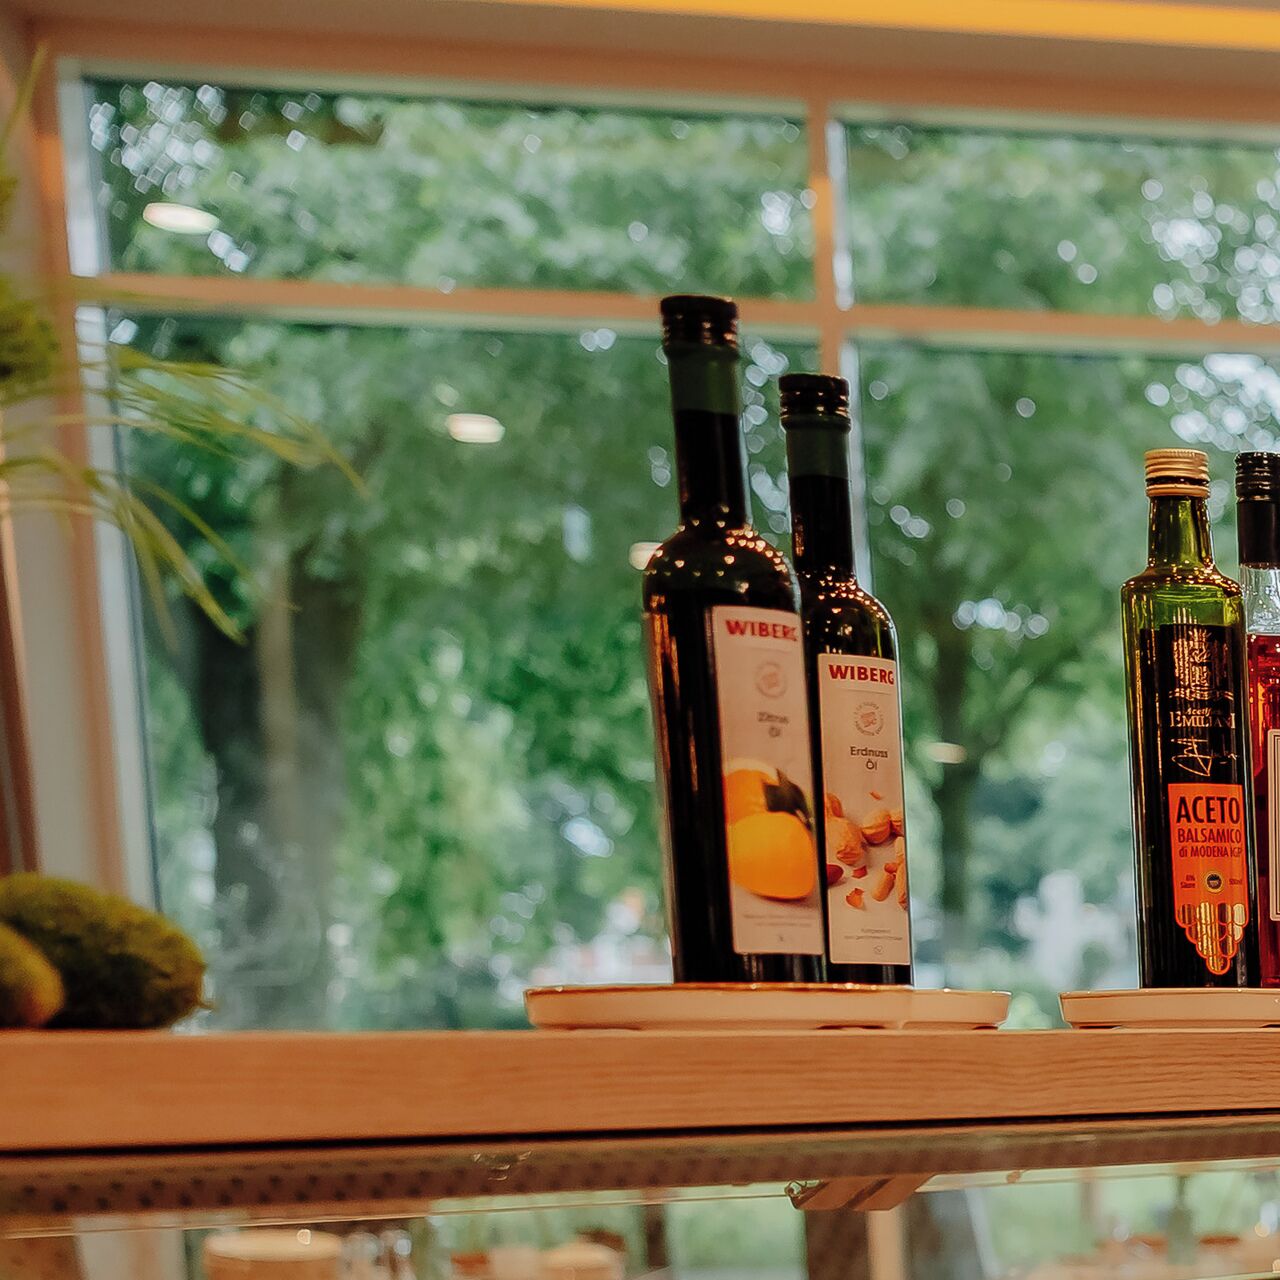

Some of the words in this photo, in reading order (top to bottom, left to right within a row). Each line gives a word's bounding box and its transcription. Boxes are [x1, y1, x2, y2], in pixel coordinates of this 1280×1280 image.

[828, 664, 895, 685] WIBERG
[849, 746, 889, 758] Erdnuss
[865, 758, 878, 771] Öl
[1176, 795, 1241, 825] ACETO
[1177, 828, 1242, 844] BALSAMICO
[1178, 846, 1188, 858] di
[1190, 846, 1229, 858] MODENA
